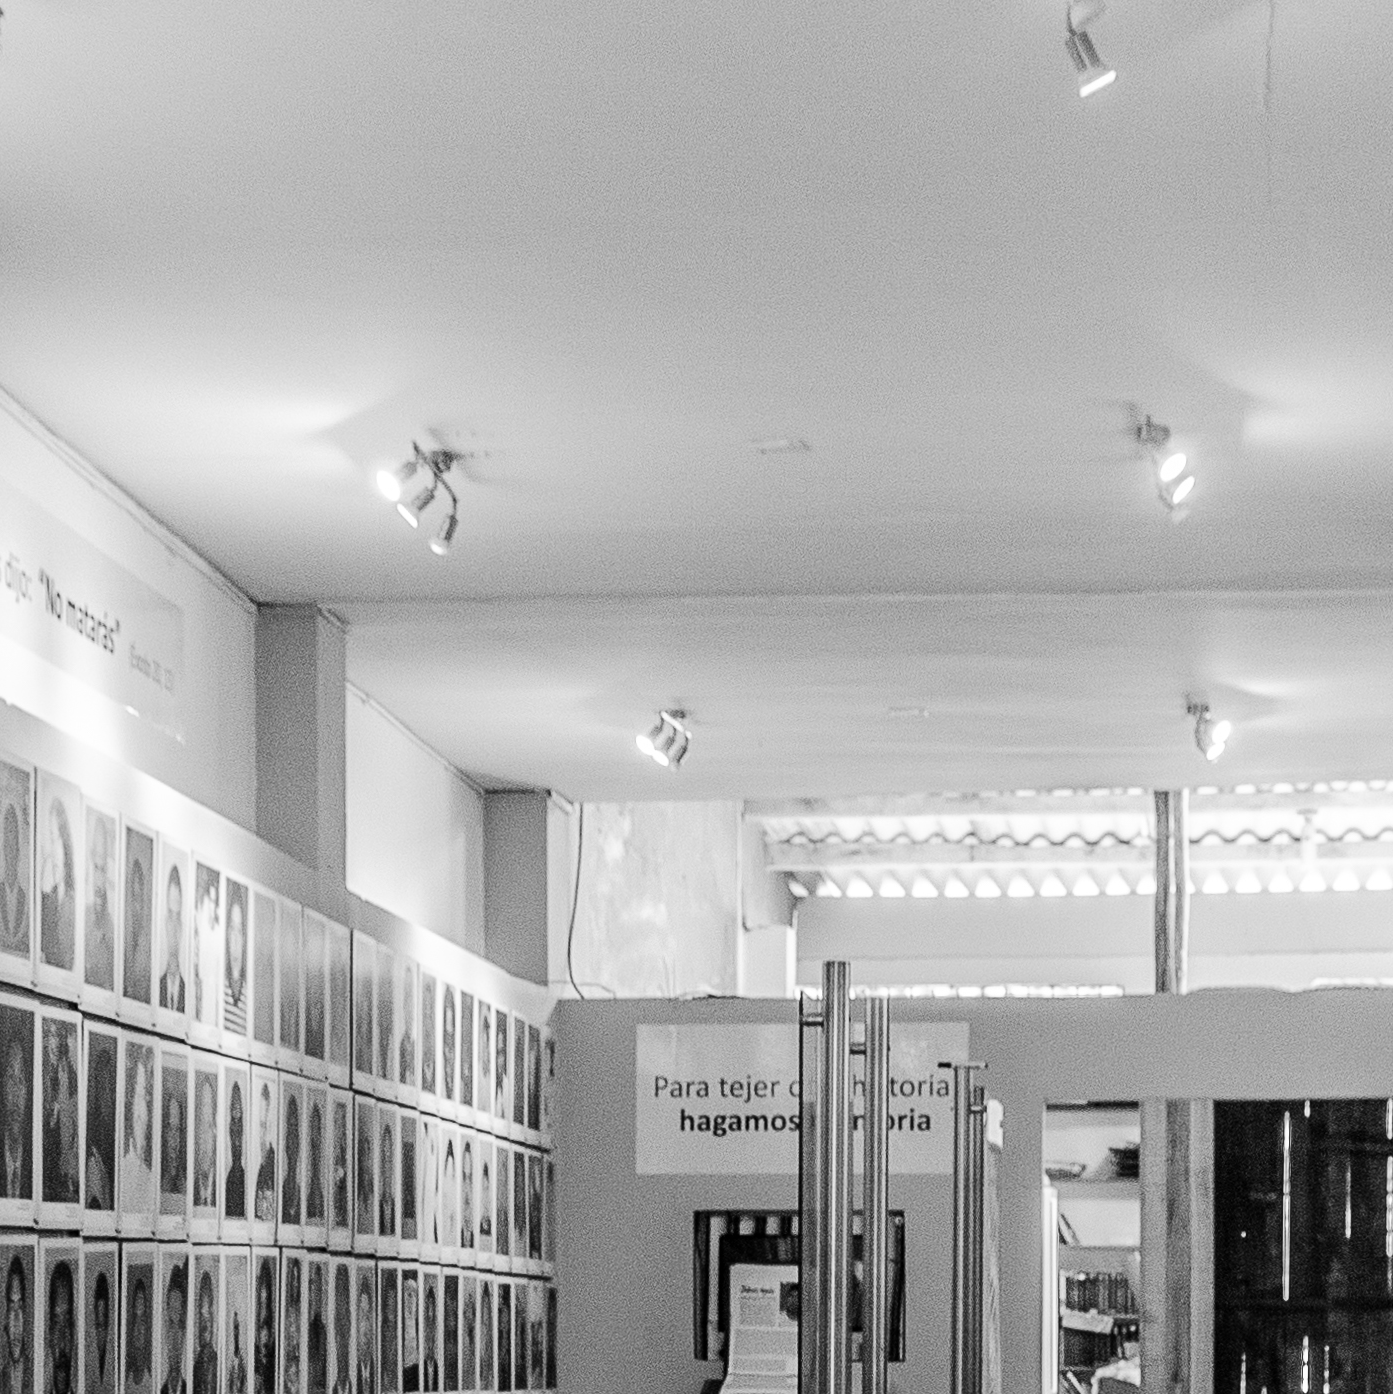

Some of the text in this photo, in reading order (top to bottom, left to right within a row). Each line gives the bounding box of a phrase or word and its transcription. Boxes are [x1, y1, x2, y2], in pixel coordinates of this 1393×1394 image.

[654, 1075, 710, 1099] Para
[719, 1074, 781, 1104] tejer
[852, 1074, 950, 1099] htoria
[679, 1108, 800, 1138] hagamos
